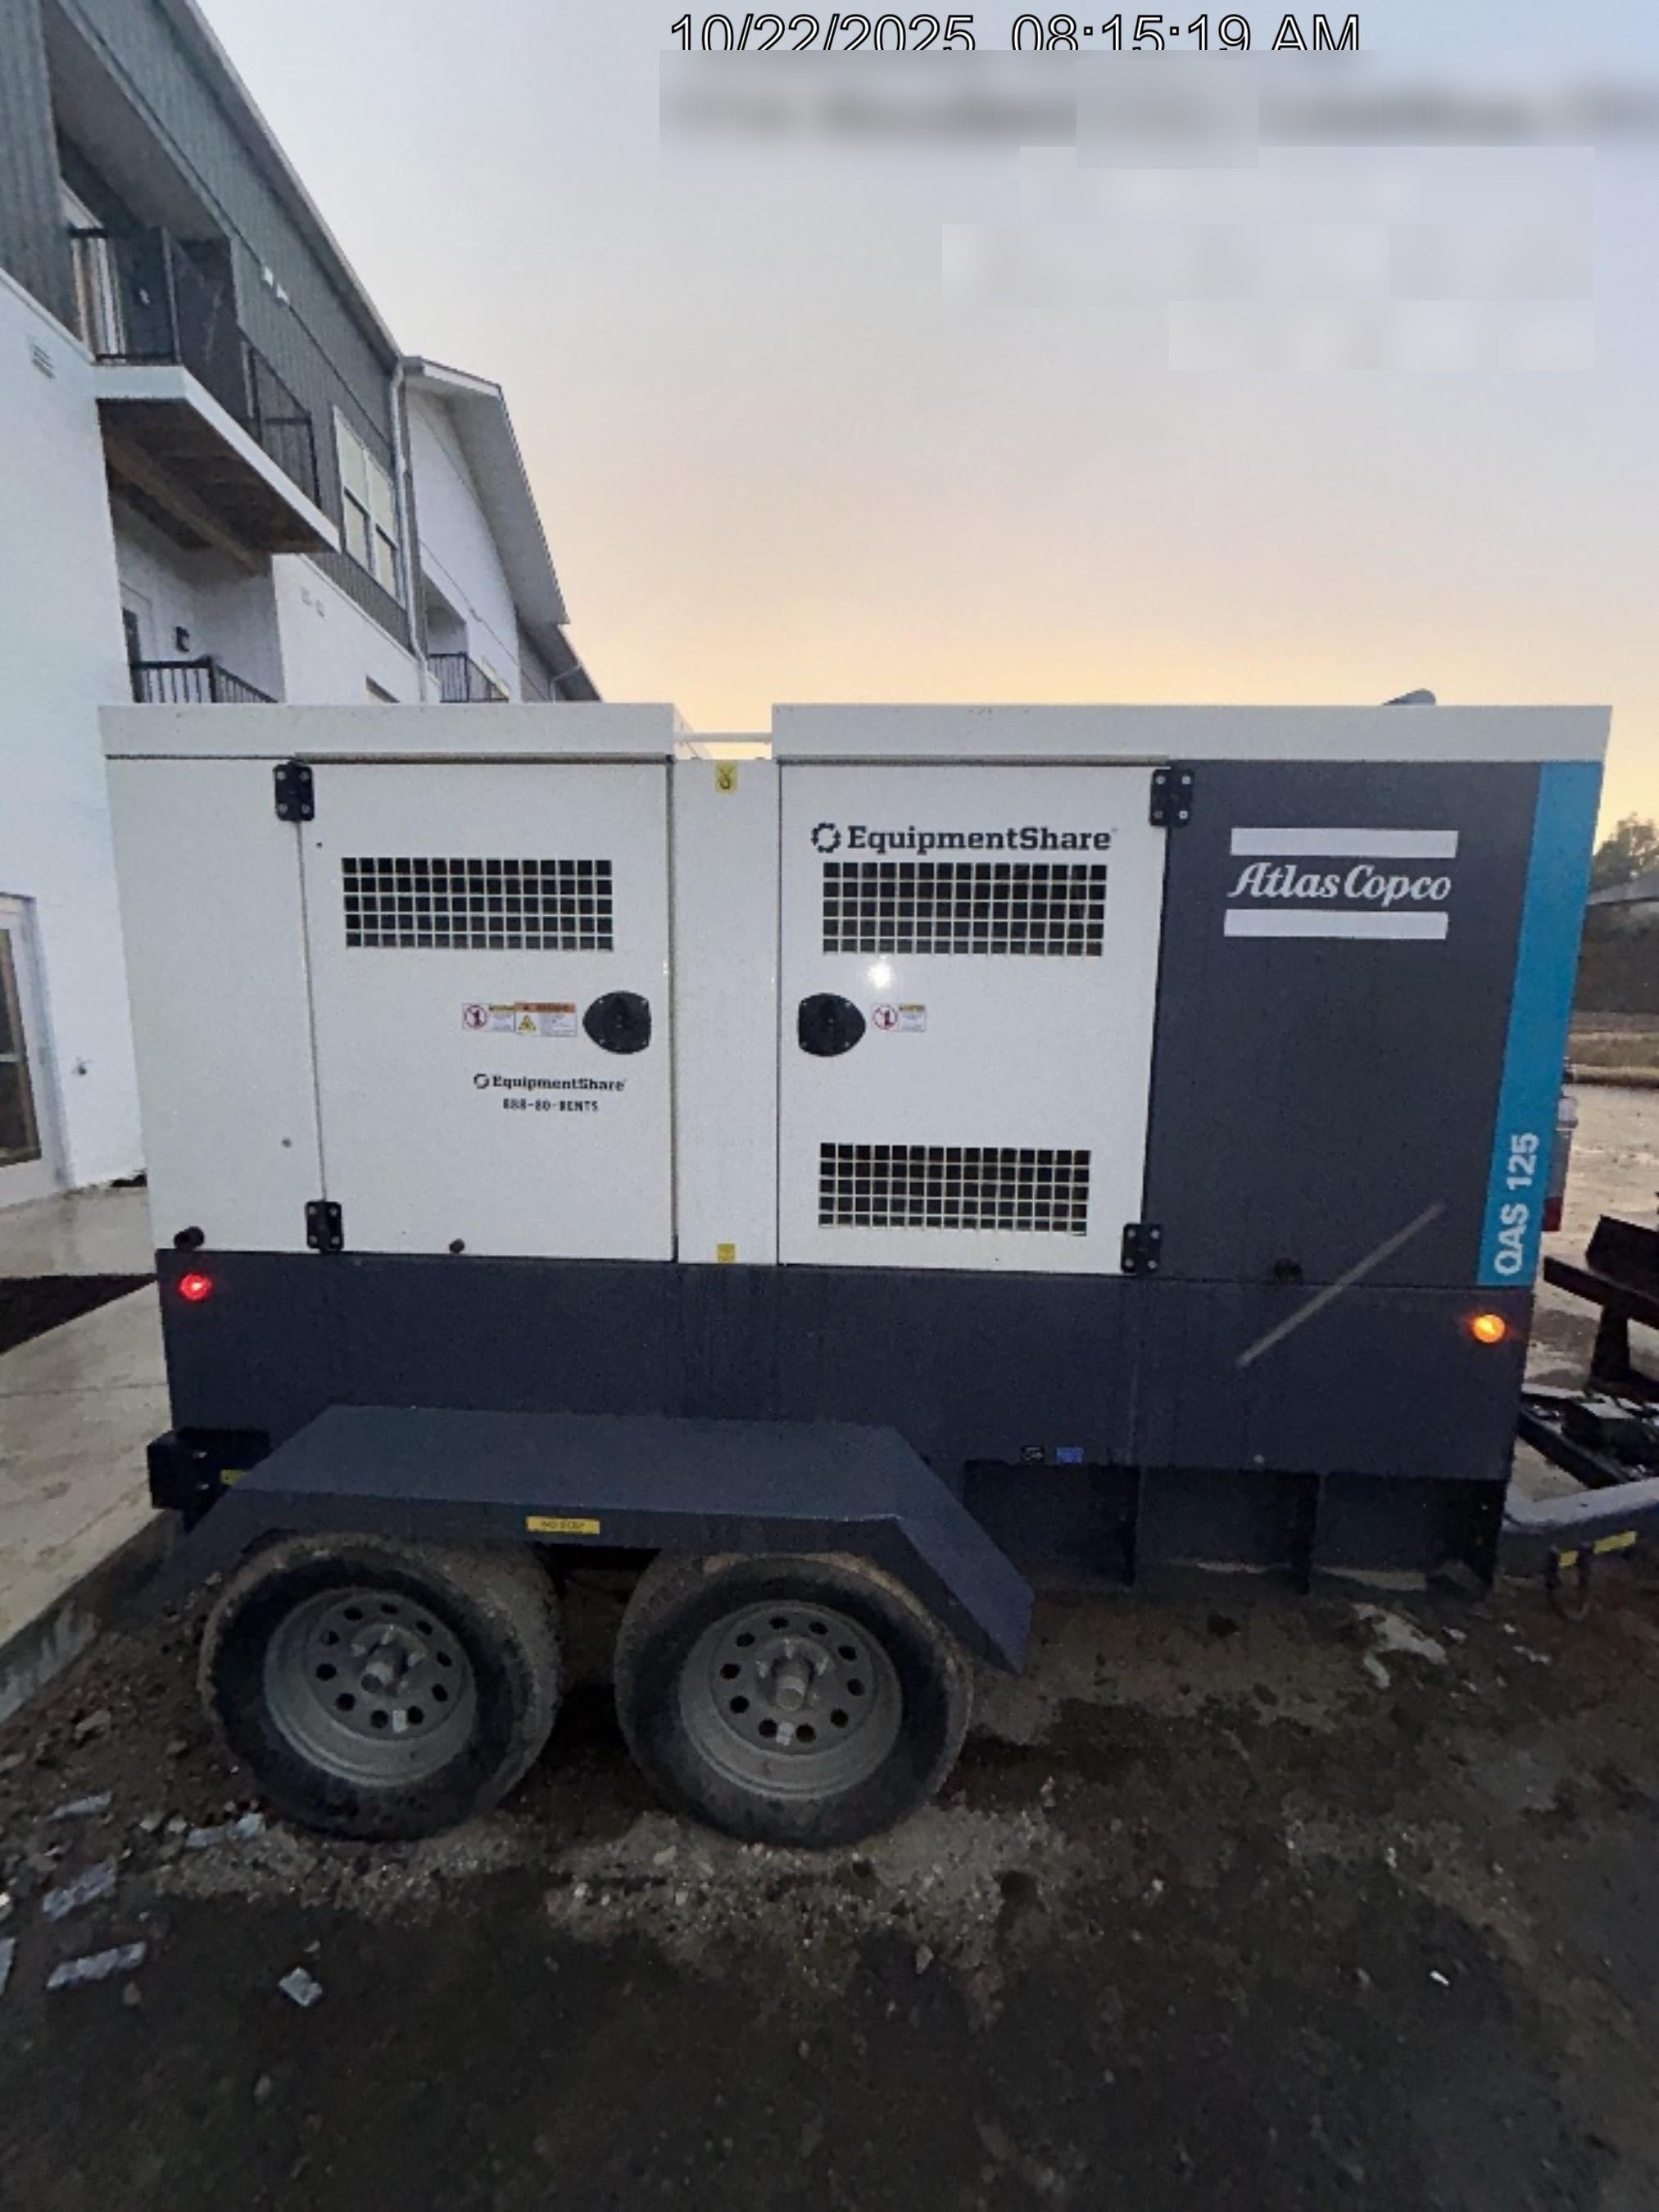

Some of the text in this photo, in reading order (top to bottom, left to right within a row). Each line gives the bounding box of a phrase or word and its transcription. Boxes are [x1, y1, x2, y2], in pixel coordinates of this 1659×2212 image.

[847, 825, 1112, 855] EquipmentShare
[1228, 862, 1452, 907] Atlas Copco
[492, 1075, 625, 1091] EquipmentShare
[1494, 1132, 1539, 1275] QAS 125
